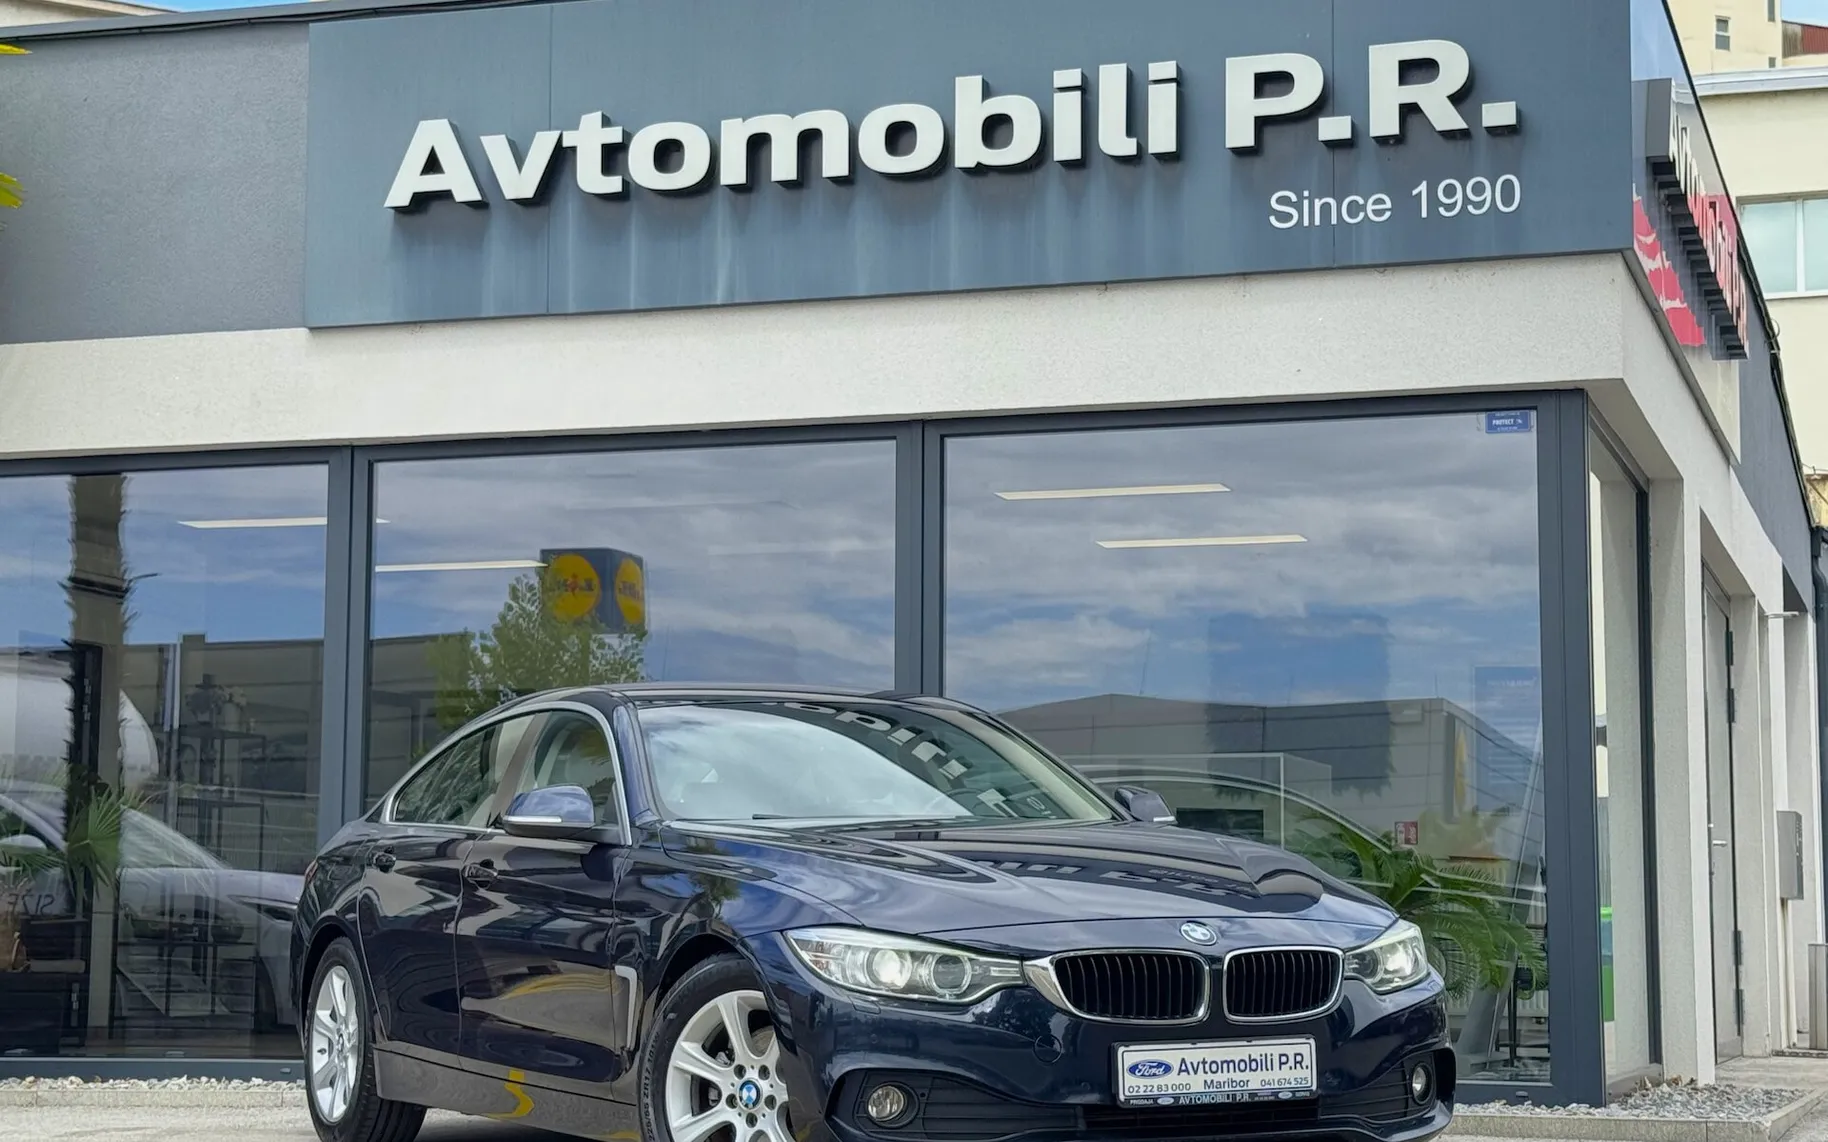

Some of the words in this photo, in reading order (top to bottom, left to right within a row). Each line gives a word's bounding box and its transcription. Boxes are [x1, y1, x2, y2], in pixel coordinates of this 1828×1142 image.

[384, 60, 1179, 211] Avtomobili
[1225, 39, 1518, 154] P.R.
[1268, 189, 1393, 229] Since
[1411, 174, 1521, 219] 1990
[1134, 1062, 1166, 1076] Ford
[1177, 1052, 1274, 1076] Avtomobili
[1278, 1052, 1309, 1071] P.R.
[1127, 1085, 1141, 1094] 02
[1143, 1084, 1155, 1093] 22
[1156, 1083, 1169, 1092] 83
[1171, 1082, 1191, 1092] 000
[1203, 1077, 1250, 1091] Maribor
[1260, 1079, 1275, 1087] 041
[1277, 1077, 1292, 1086] 674
[1293, 1076, 1309, 1085] 525
[1178, 1092, 1232, 1105] AVTOMOBILI
